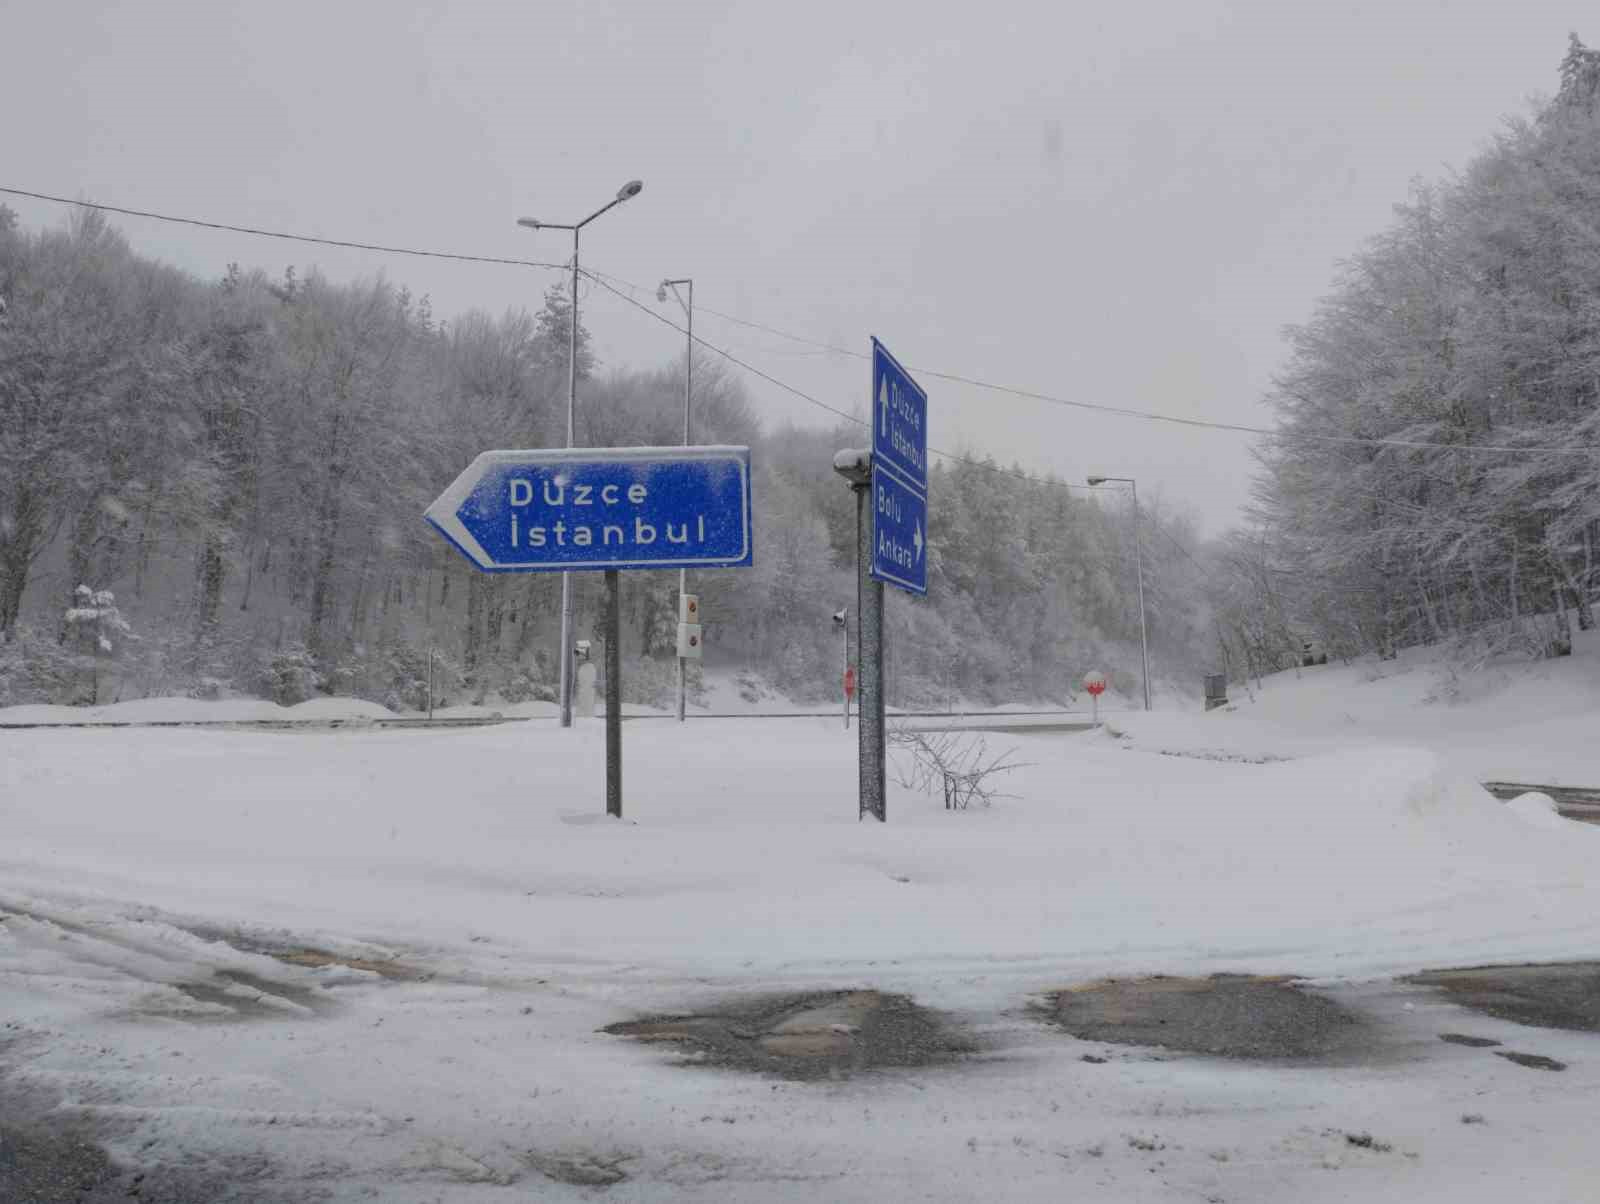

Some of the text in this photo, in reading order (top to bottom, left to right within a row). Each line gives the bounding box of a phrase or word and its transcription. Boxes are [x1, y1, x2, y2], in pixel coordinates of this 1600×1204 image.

[510, 478, 648, 507] Düzce
[878, 485, 901, 523] Bolu
[511, 513, 705, 547] İstanbul
[878, 530, 912, 569] Ankara
